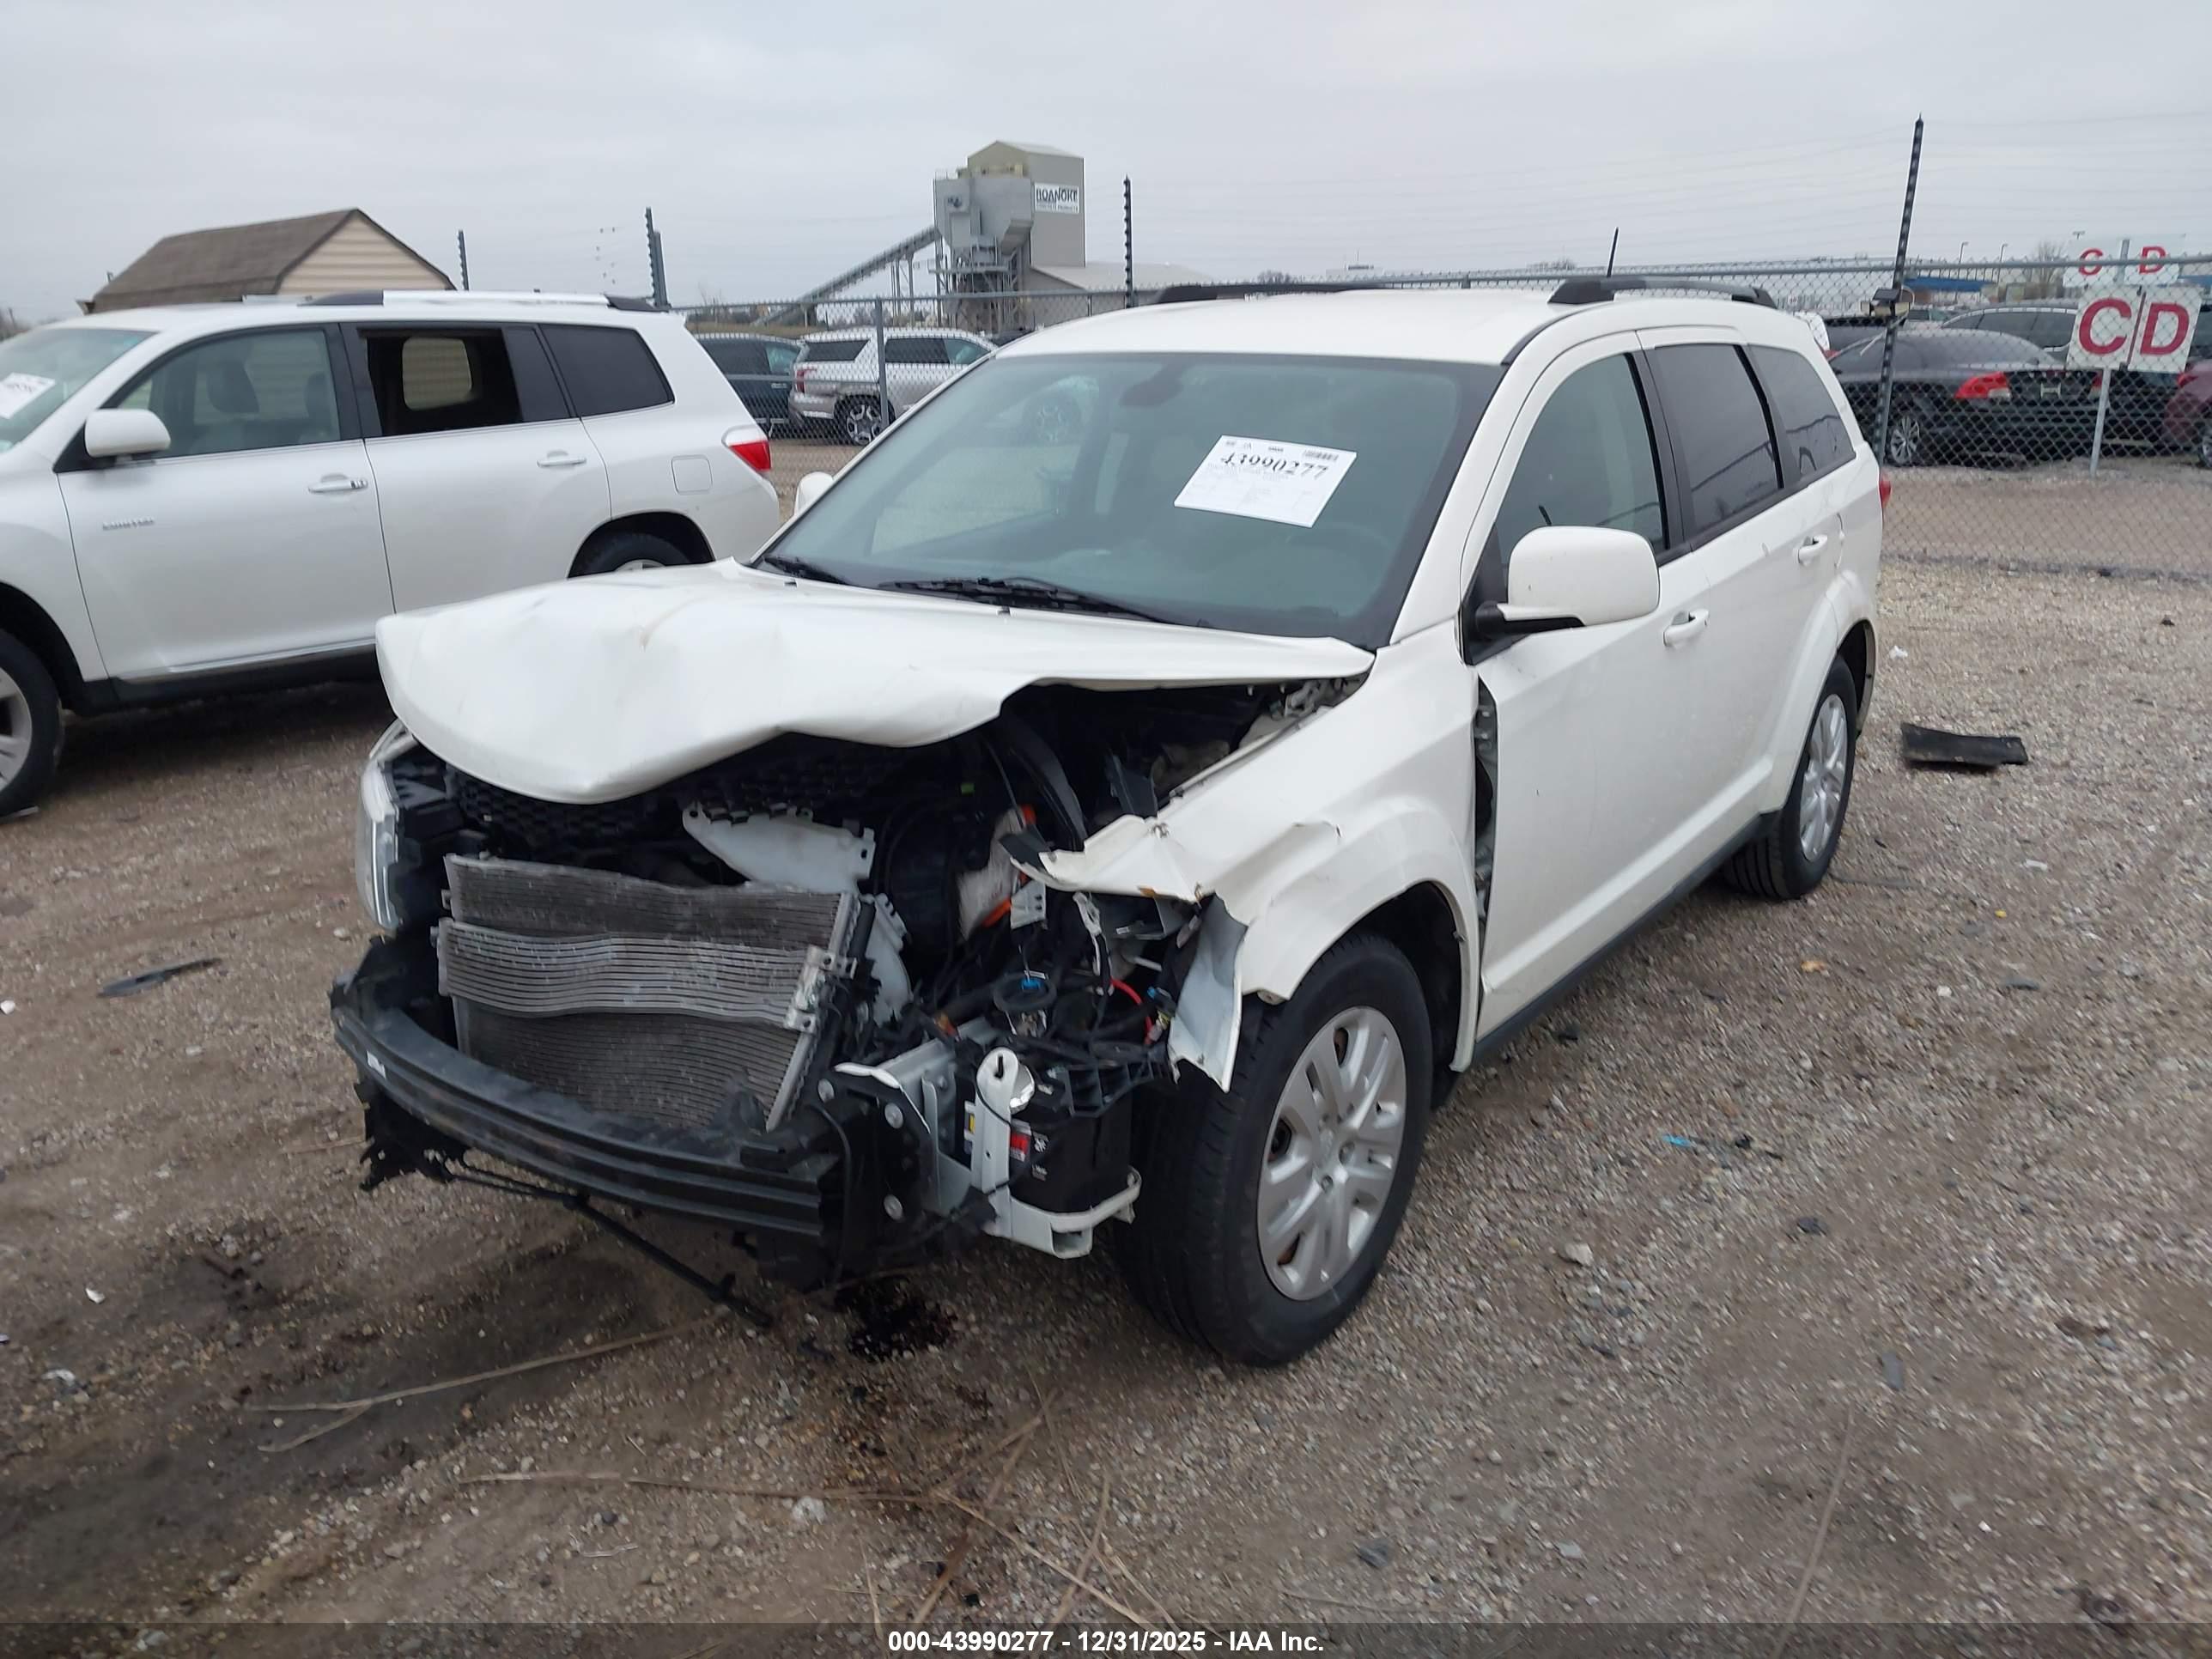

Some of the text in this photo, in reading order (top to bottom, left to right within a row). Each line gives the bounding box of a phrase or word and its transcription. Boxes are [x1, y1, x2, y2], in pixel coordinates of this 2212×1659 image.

[2078, 246, 2166, 275] C D
[2079, 298, 2190, 355] C D
